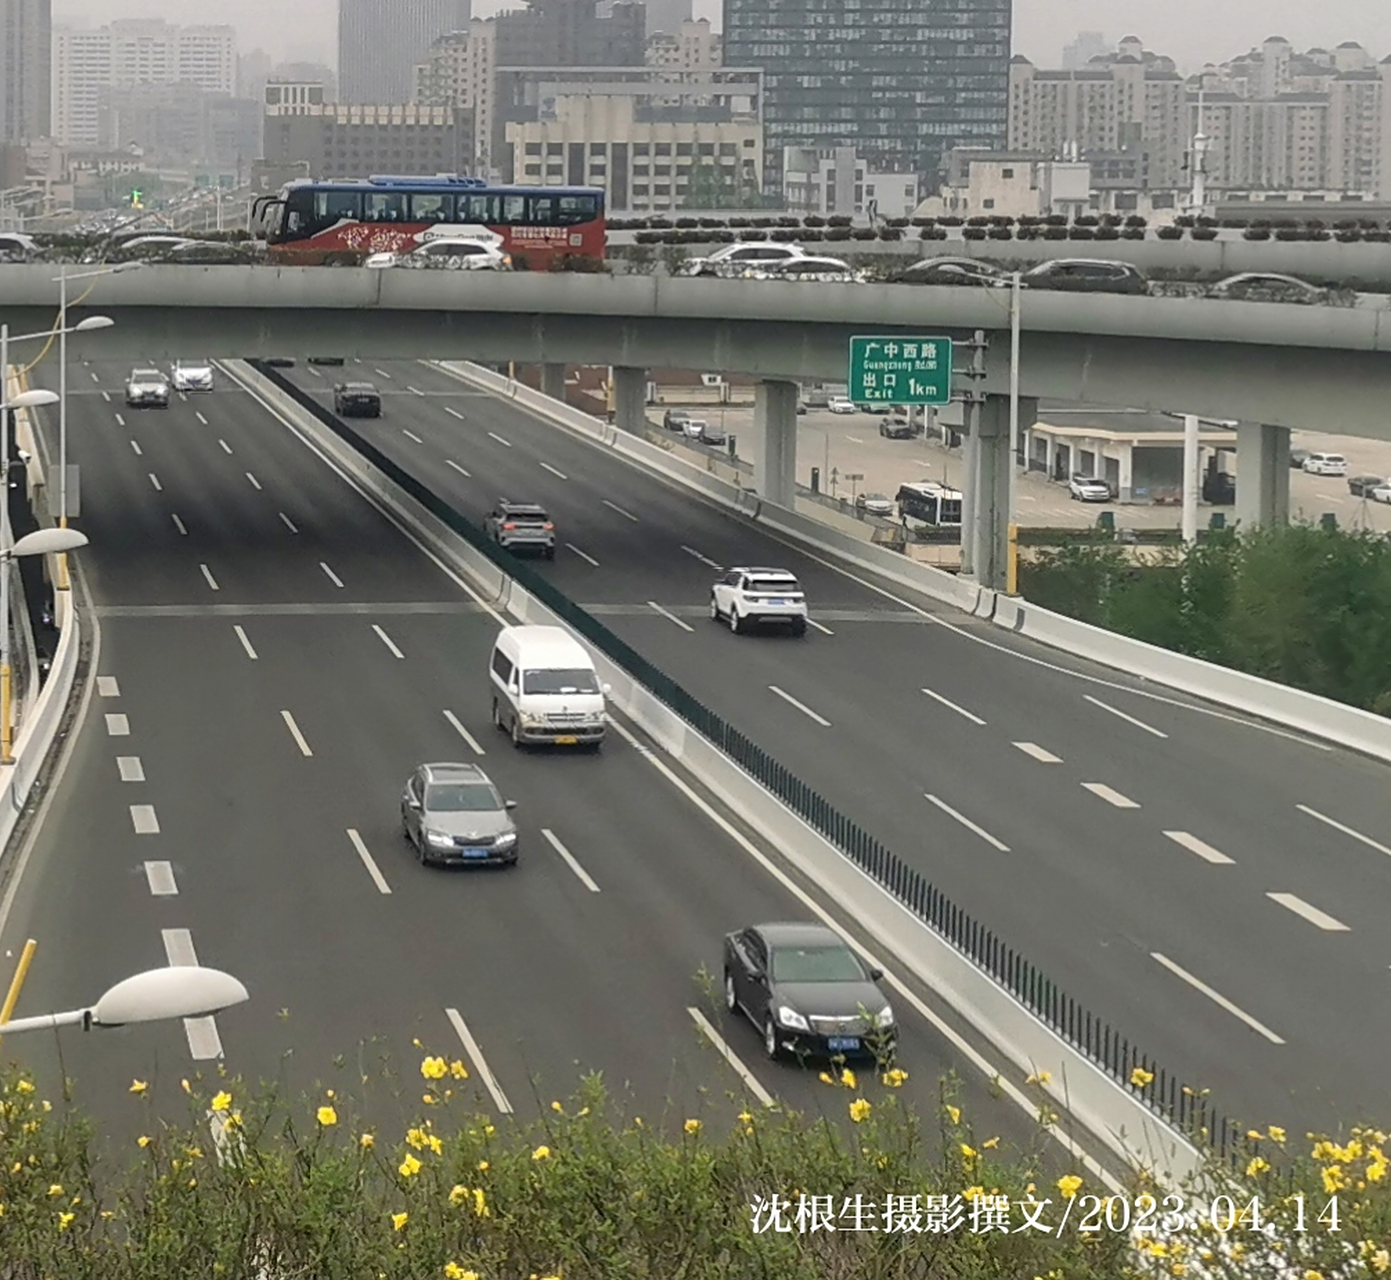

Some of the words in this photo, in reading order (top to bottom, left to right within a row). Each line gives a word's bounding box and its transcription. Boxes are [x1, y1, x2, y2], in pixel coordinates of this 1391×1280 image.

[864, 342, 937, 359] 广中西路
[862, 372, 896, 387] 出口
[864, 389, 894, 399] Exit
